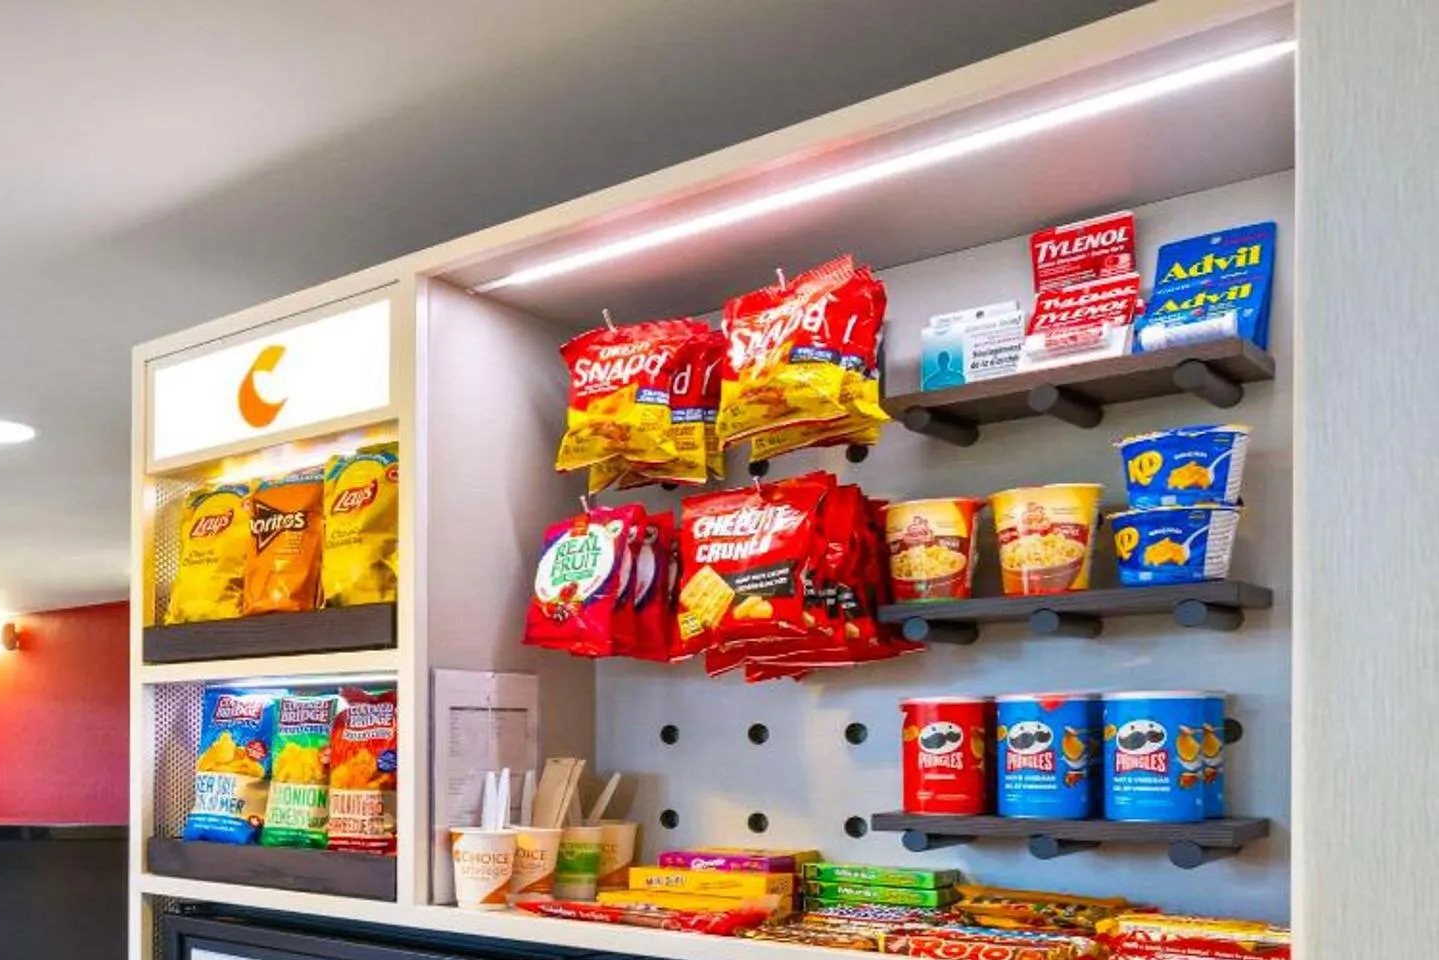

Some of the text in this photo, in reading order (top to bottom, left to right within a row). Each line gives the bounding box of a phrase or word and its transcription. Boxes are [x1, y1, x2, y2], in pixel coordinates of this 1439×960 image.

[1035, 227, 1130, 264] TYLENOL
[1160, 244, 1261, 285] Advil
[1156, 283, 1252, 315] Advil
[250, 511, 305, 534] oritos
[555, 532, 602, 561] REAL
[551, 551, 602, 577] FRUIT
[918, 752, 963, 770] PRINGLES
[1007, 752, 1053, 771] PRINGLES
[1116, 752, 1166, 772] PRINGLES
[515, 849, 547, 862] OICE
